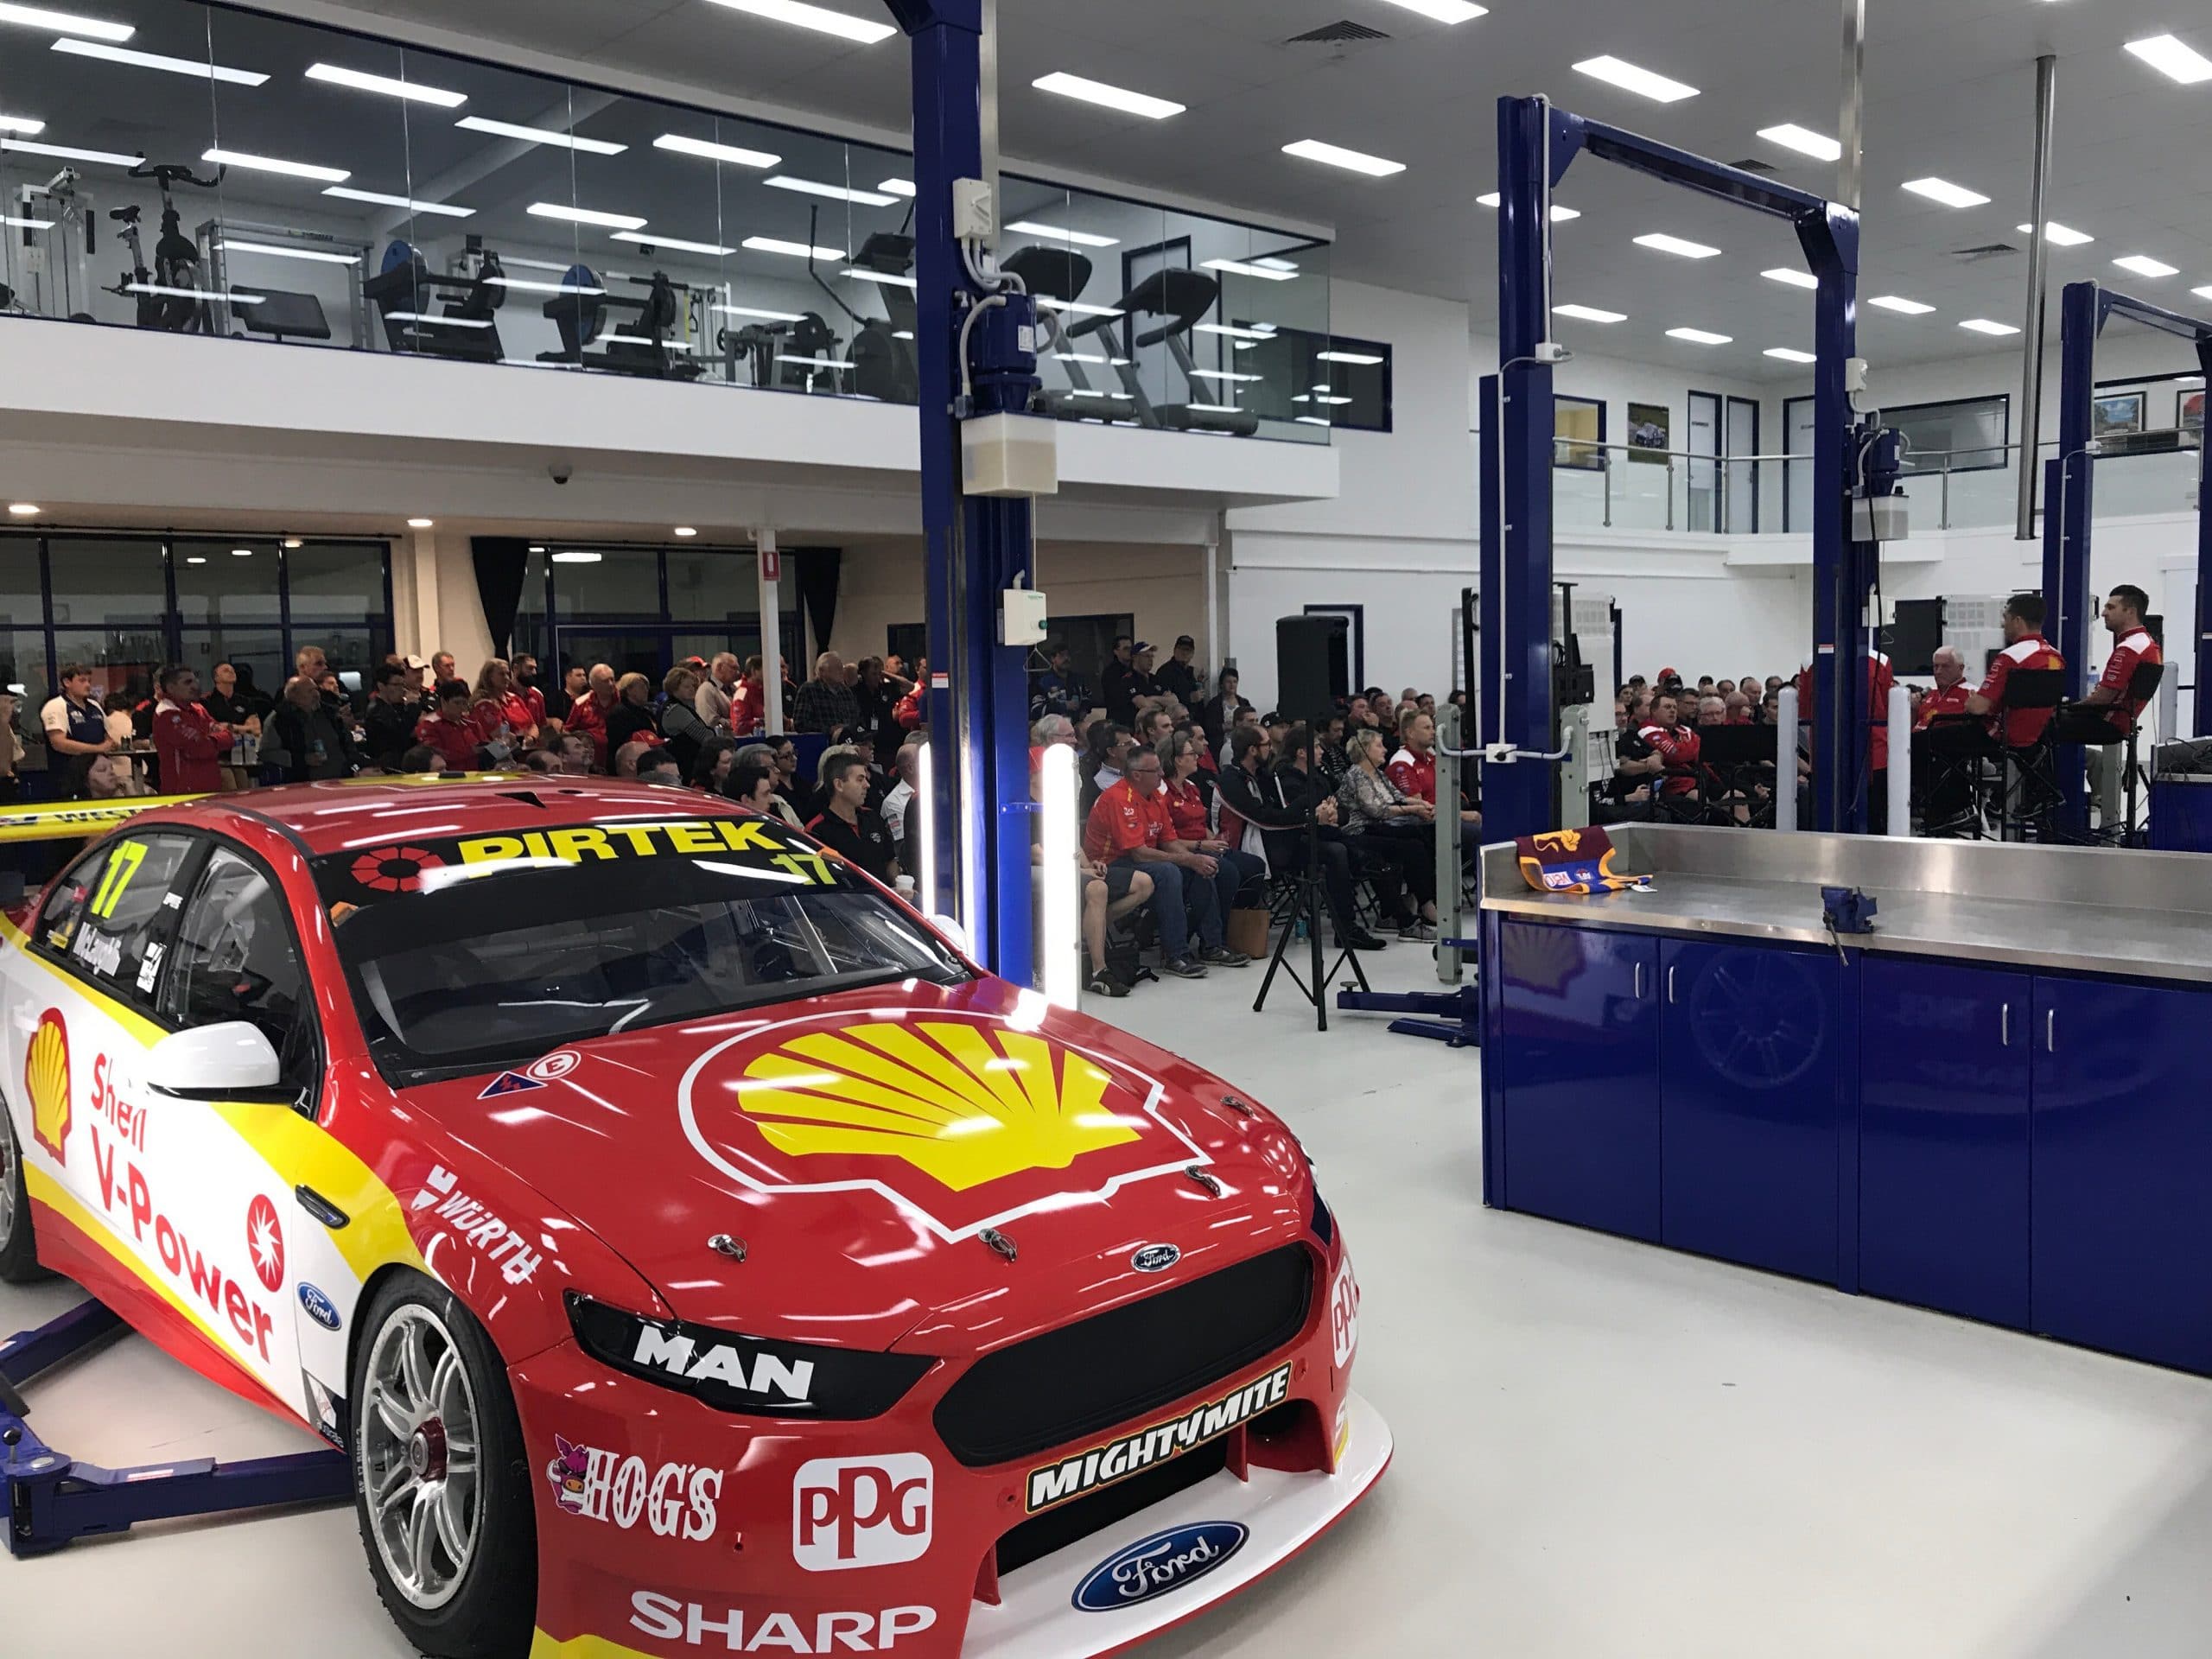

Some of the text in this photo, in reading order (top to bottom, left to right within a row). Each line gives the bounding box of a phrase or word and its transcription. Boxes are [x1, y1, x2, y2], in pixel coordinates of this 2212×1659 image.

[91, 840, 149, 918] 17
[458, 821, 786, 879] PIRTEK
[770, 854, 838, 885] 17
[91, 1052, 147, 1154] Shell
[544, 1057, 565, 1074] E
[91, 1123, 273, 1364] V-Power
[434, 1190, 543, 1285] WÜRTH
[305, 1288, 333, 1325] Ford
[633, 1325, 815, 1400] MAN
[580, 1446, 724, 1541] HOG'S
[799, 1465, 927, 1560] PPG
[1111, 1535, 1221, 1598] Ford
[629, 1590, 938, 1654] SHARP
